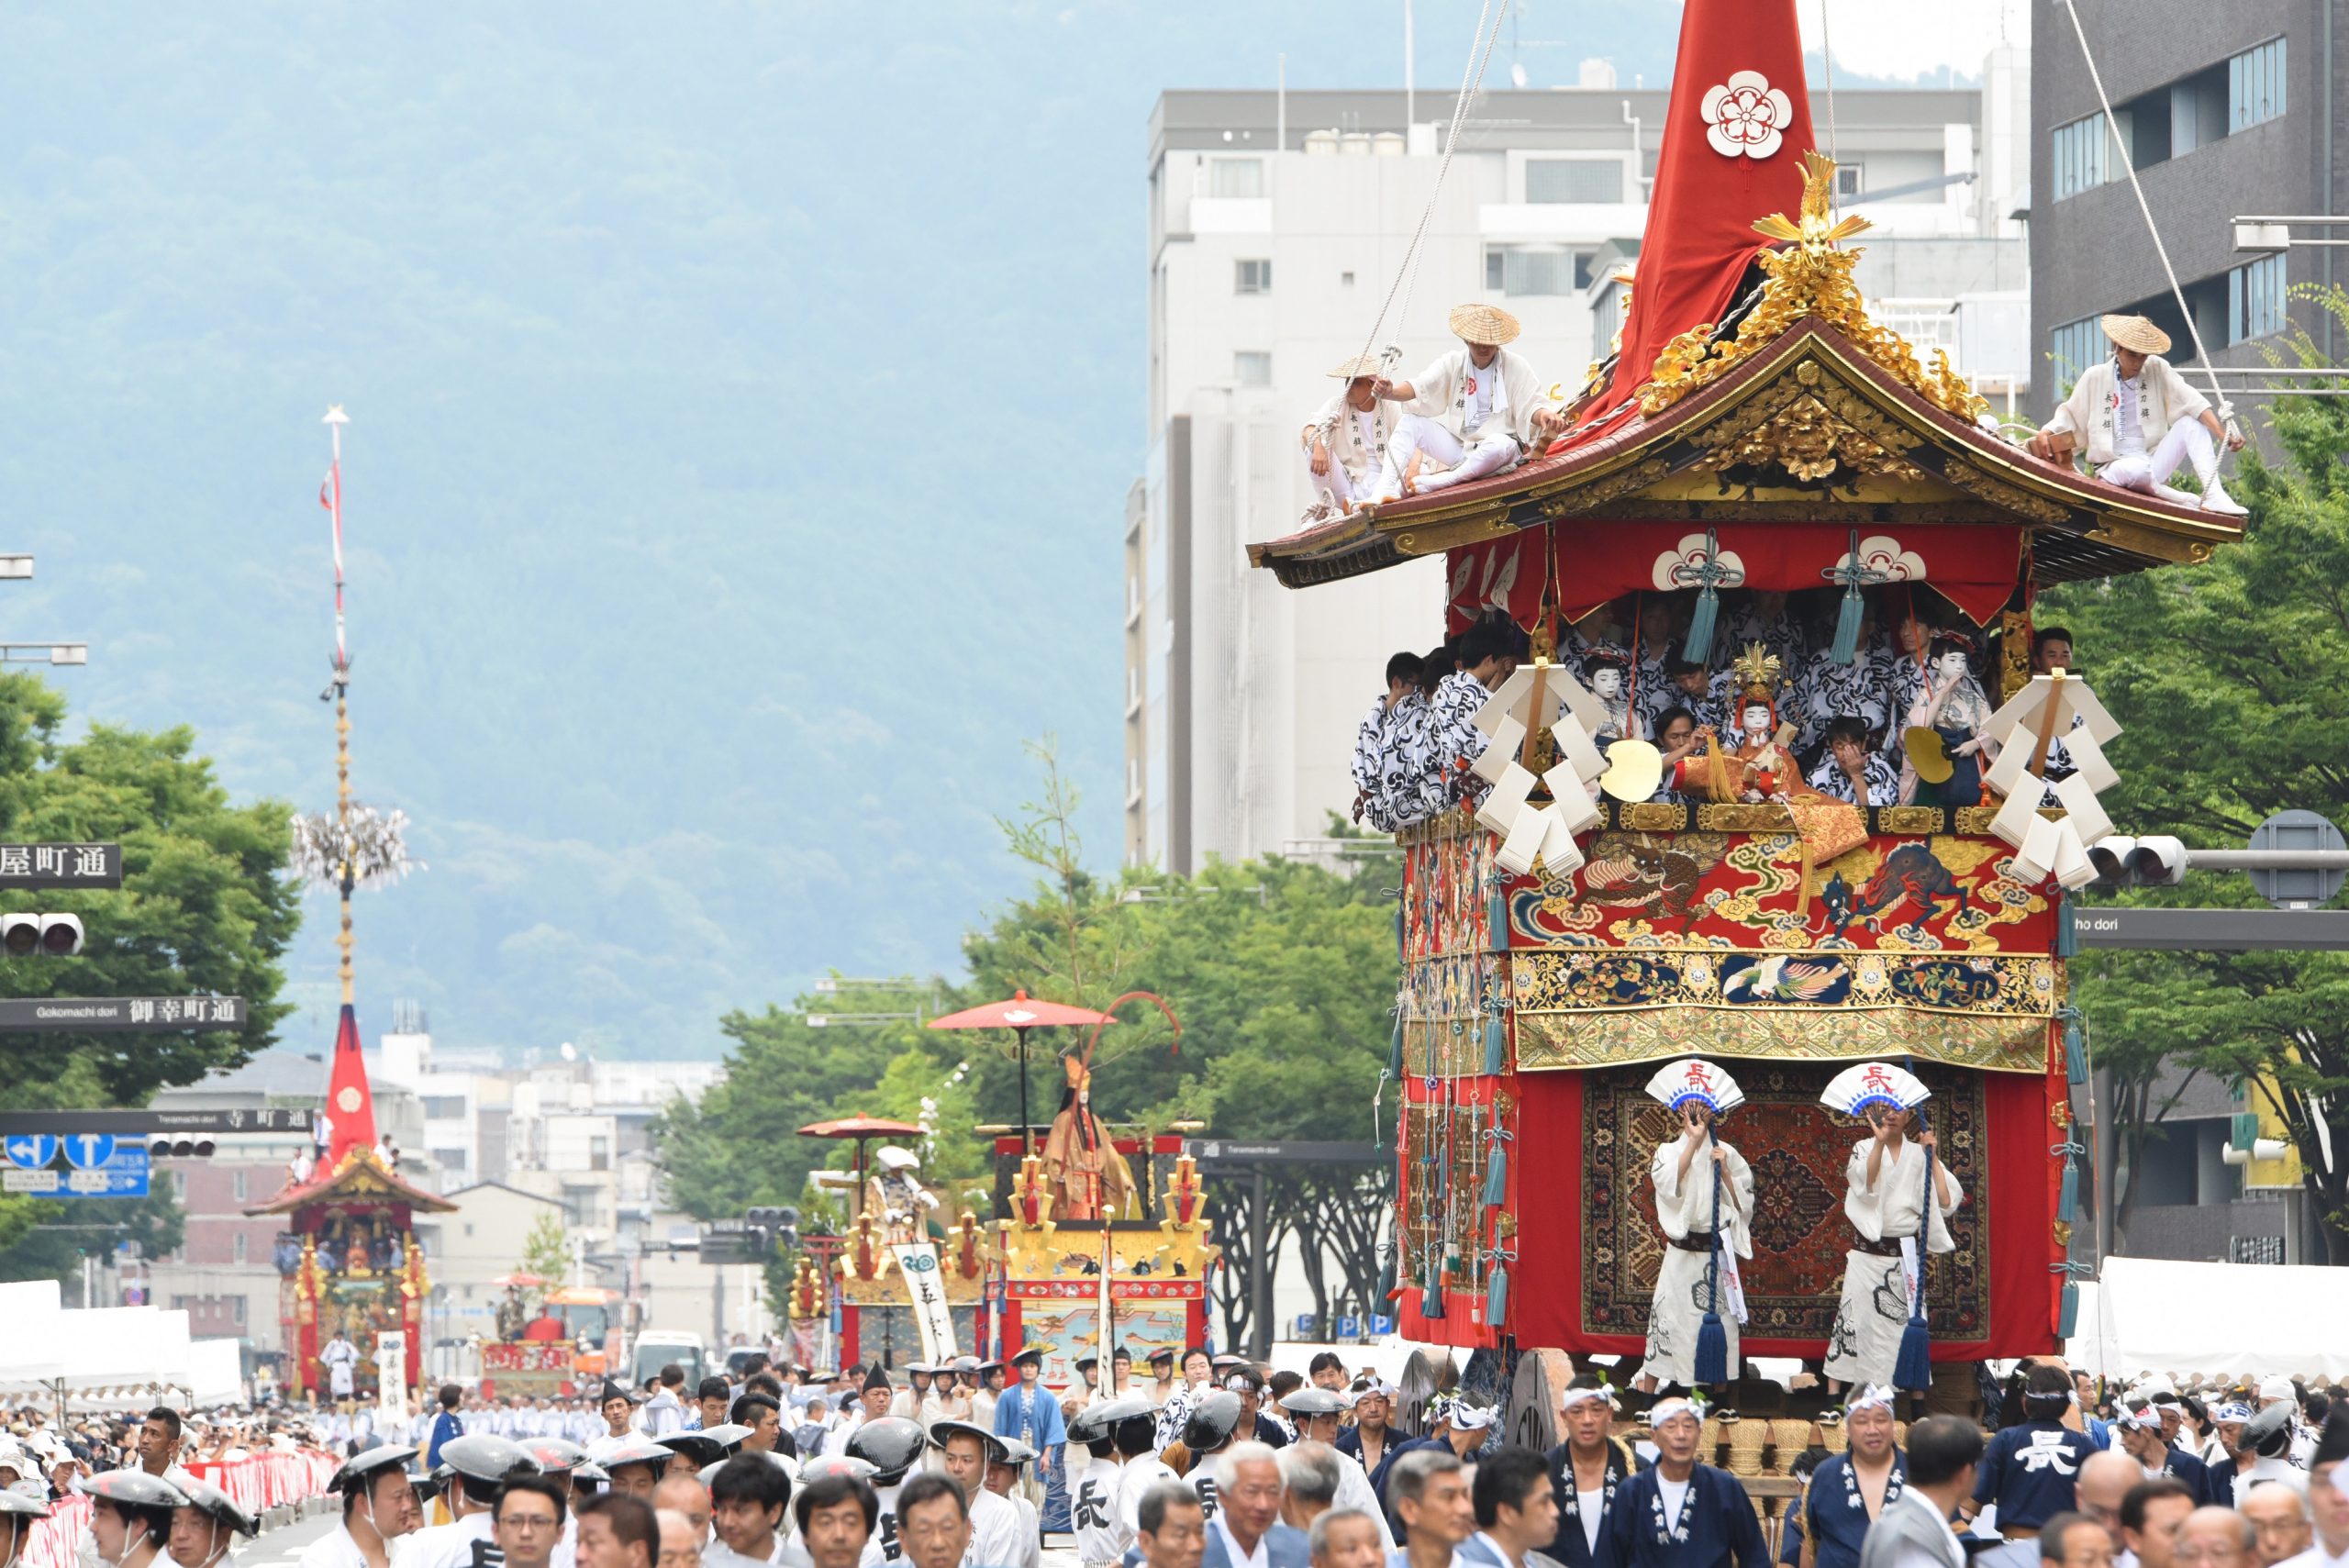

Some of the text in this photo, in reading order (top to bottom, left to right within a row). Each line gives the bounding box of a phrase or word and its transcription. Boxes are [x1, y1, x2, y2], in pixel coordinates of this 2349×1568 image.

[2102, 392, 2113, 430] 長刀鉾
[2140, 379, 2150, 419] 長刀鉾
[1351, 411, 1362, 448] 長刀鉾
[0, 846, 107, 877] 屋町通
[2094, 917, 2118, 930] dori
[36, 1006, 117, 1018] Gokomachi dori
[129, 998, 237, 1022] 御幸町通
[1685, 1062, 1713, 1093] 長
[1862, 1065, 1893, 1094] 長
[227, 1108, 307, 1128] 寺町通
[1342, 1318, 1356, 1335] P
[1375, 1315, 1388, 1333] P
[2014, 1429, 2078, 1475] 長
[1561, 1463, 1578, 1517] 長刀鉾
[1841, 1462, 1863, 1509] 長刀鉾
[1074, 1478, 1110, 1530] 長
[1651, 1494, 1670, 1546] 長刀鉾
[1675, 1487, 1697, 1544] 長刀鉾
